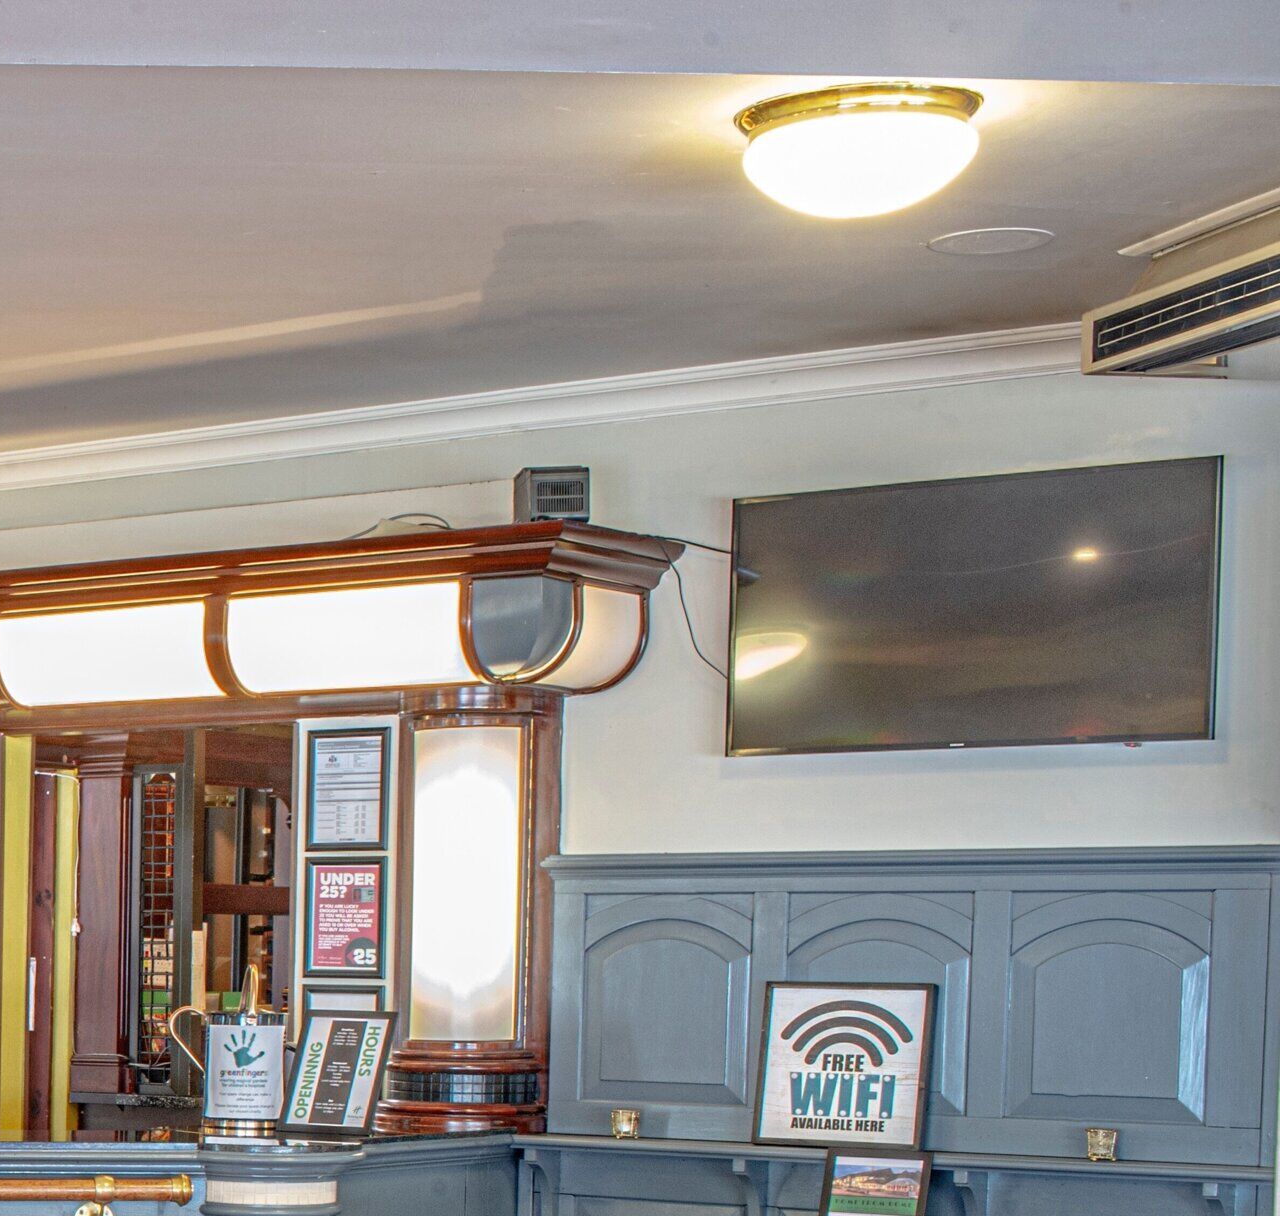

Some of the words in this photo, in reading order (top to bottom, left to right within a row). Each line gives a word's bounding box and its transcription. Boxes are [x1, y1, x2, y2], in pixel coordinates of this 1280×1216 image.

[320, 873, 375, 885] UNDER
[320, 886, 347, 898] 25?
[353, 948, 377, 965] 25
[359, 1026, 381, 1077] HOURS
[822, 1054, 865, 1072] FREE
[790, 1072, 896, 1119] WIFI
[790, 1117, 852, 1131] AVAILABLE
[855, 1119, 885, 1132] HERE
